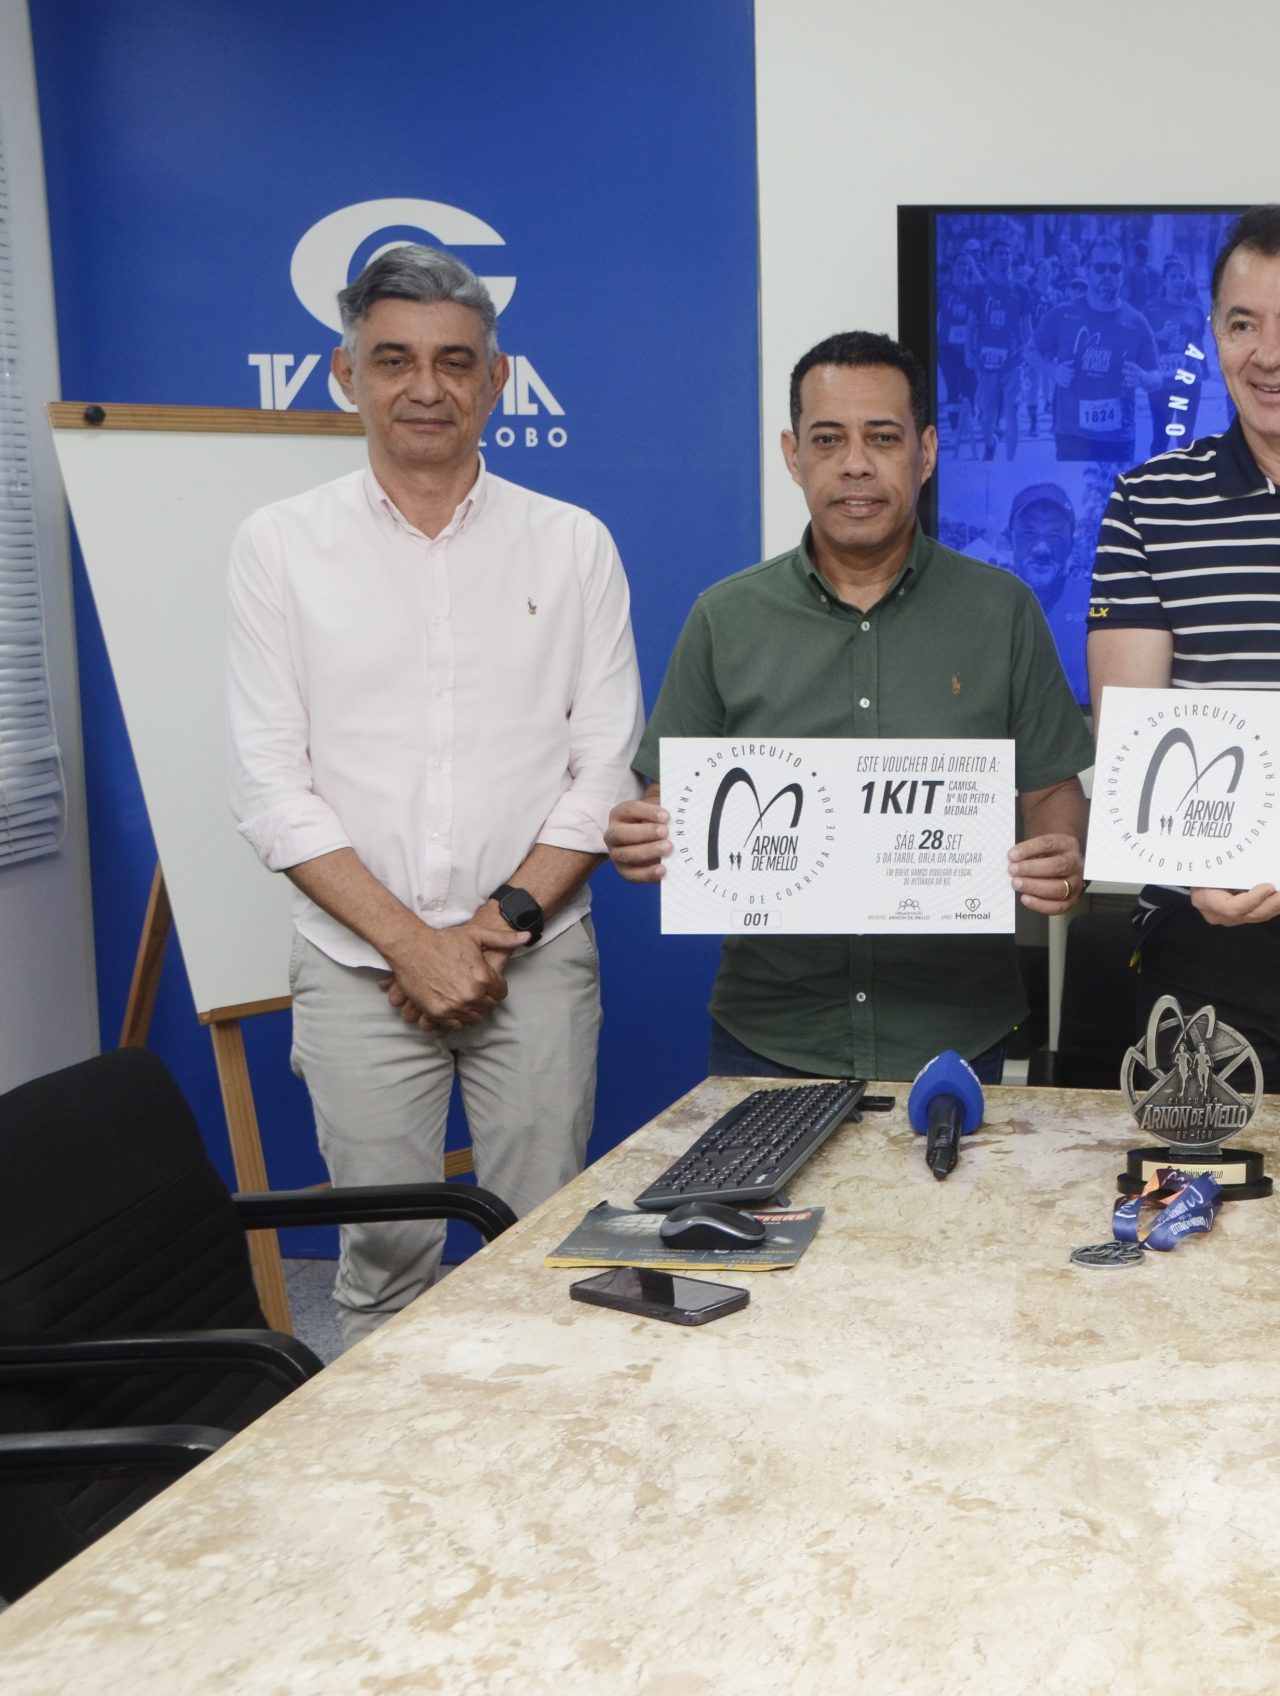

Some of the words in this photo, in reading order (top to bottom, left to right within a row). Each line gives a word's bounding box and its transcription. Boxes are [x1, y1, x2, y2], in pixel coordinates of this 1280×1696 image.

[247, 353, 322, 411] TV
[1165, 342, 1205, 437] ARNO
[1084, 409, 1114, 423] 1824
[478, 427, 568, 448] OBO
[1174, 704, 1246, 730] CIRCUITO
[731, 744, 803, 768] CIRCUITO
[856, 756, 880, 773] ESTE
[882, 756, 928, 773] VOUCHER
[931, 753, 945, 773] DÁ
[947, 756, 987, 773] DIREITO
[1259, 750, 1275, 780] RUA
[1107, 744, 1130, 796] ARNON
[817, 785, 835, 814] RUA
[861, 780, 876, 814] 1
[880, 780, 945, 814] KIT
[957, 793, 968, 803] NO
[969, 793, 990, 804] PEITO
[990, 793, 996, 803] E
[1263, 791, 1276, 809] DE
[675, 785, 693, 836] ARNON
[943, 805, 978, 816] MEDALHA
[1109, 807, 1123, 825] DE
[1183, 799, 1236, 822] ARNON
[825, 825, 836, 841] DE
[1182, 820, 1199, 837] DE
[1199, 821, 1233, 838] MELLO
[751, 835, 799, 856] ARNON
[1121, 832, 1165, 868] MELLO
[1205, 819, 1267, 869] CORRIDA
[679, 847, 694, 864] DE
[751, 855, 763, 871] DE
[765, 855, 798, 871] MELLO
[876, 853, 881, 864] 5
[882, 853, 893, 864] DA
[918, 853, 936, 864] ORLA
[937, 853, 947, 864] DA
[948, 853, 982, 865] PAJUÇARA
[776, 851, 830, 901] CORRIDA
[1176, 861, 1193, 872] DE
[694, 869, 738, 902] MELLO
[749, 895, 766, 904] DE
[743, 912, 769, 926] 001
[955, 912, 991, 920] Hemoal
[1140, 1104, 1192, 1130] ARNON
[1190, 1108, 1205, 1126] DE
[1204, 1103, 1249, 1128] MELLO
